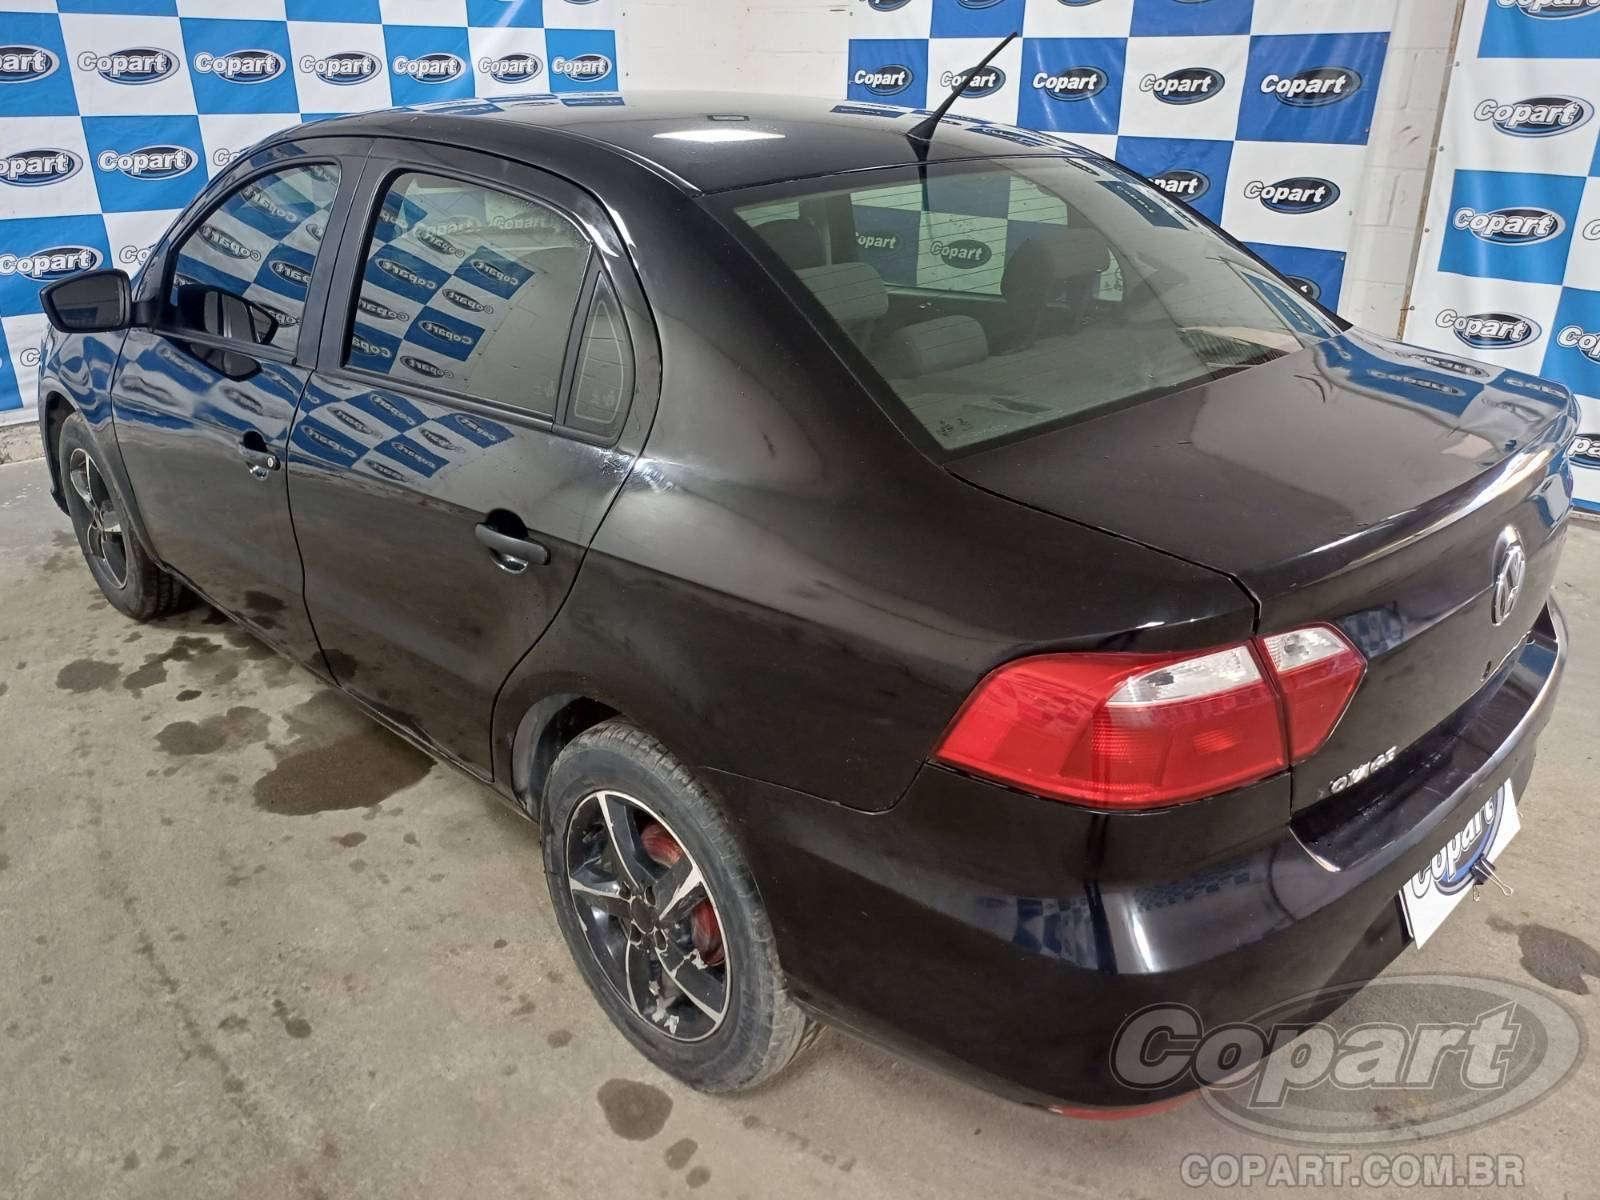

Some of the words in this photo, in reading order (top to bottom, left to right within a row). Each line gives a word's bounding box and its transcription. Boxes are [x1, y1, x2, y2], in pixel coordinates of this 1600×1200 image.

[0, 51, 46, 73] art
[77, 51, 169, 77] Copart
[194, 51, 276, 77] Copart
[299, 54, 373, 75] Copart
[392, 55, 460, 75] Copart
[478, 56, 537, 75] Copart
[552, 56, 608, 75] Copart
[854, 69, 908, 86] Copart
[1032, 72, 1099, 92] Copart
[1139, 73, 1212, 95] Copart
[1260, 74, 1348, 97] Copart
[1474, 99, 1579, 129] Copart
[0, 152, 68, 180] opart
[98, 149, 190, 175] Copart
[1244, 180, 1326, 203] Copart
[1454, 207, 1553, 236] Copart
[856, 233, 897, 249] opart
[930, 241, 984, 260] Copart
[0, 248, 91, 277] Copart
[1436, 308, 1528, 341] Copart
